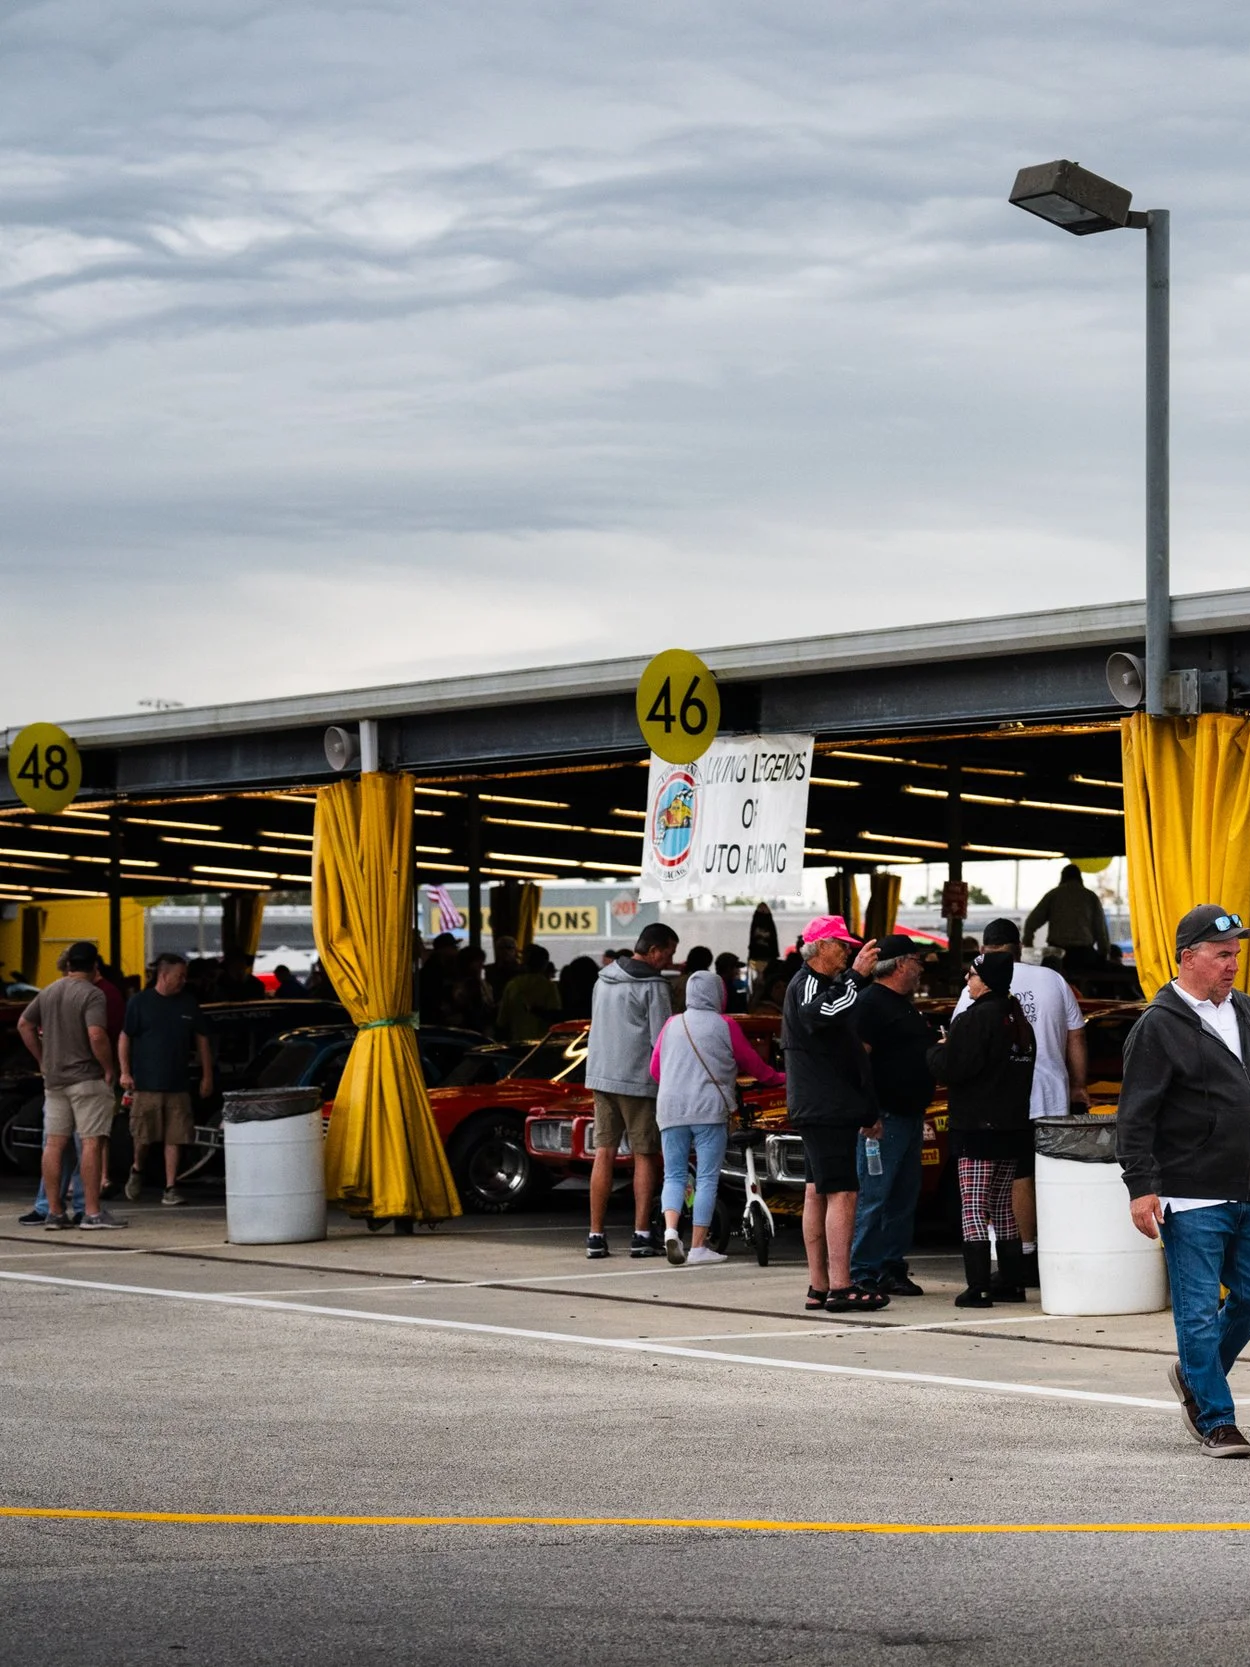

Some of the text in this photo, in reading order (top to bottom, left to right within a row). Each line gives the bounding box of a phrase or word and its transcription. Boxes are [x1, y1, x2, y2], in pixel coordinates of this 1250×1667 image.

[645, 675, 709, 736] 46
[16, 743, 70, 792] 48
[706, 755, 748, 785] LIVING
[752, 751, 807, 783] LEGENDS
[703, 843, 741, 874] UTO
